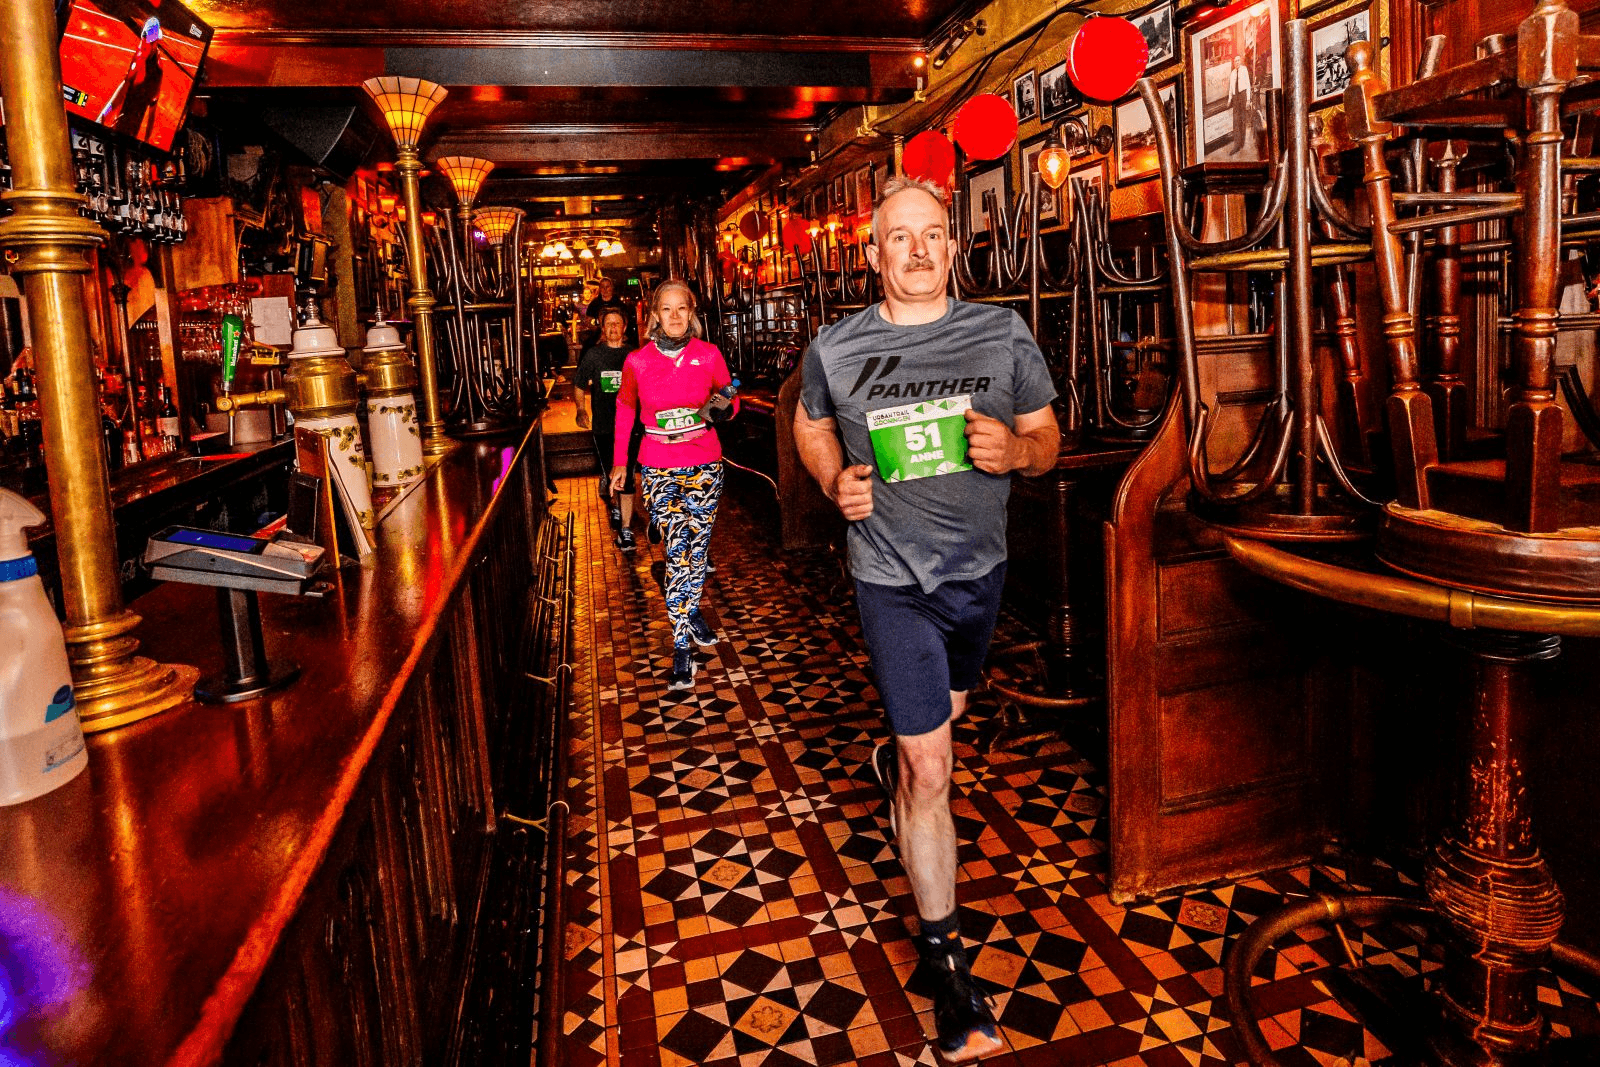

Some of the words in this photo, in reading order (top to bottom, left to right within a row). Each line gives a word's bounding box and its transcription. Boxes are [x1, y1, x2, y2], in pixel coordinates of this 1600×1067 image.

[867, 377, 991, 401] PANTHER
[664, 415, 695, 431] 450
[904, 422, 942, 451] 51
[910, 450, 945, 463] ANNE
